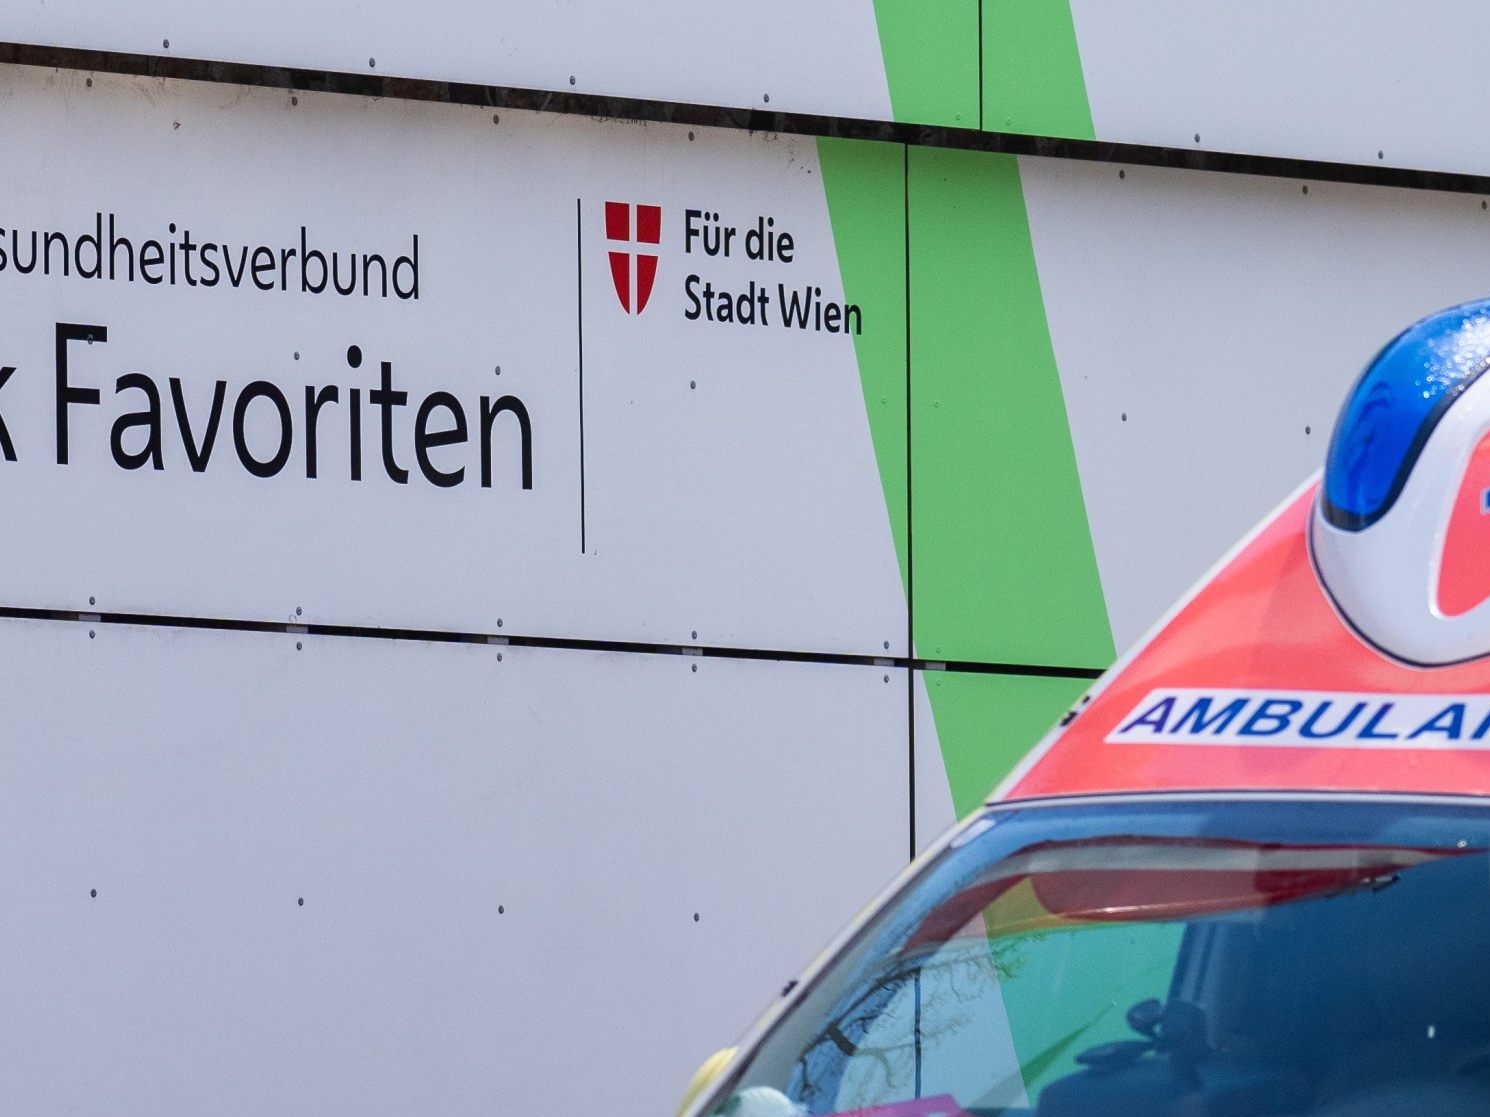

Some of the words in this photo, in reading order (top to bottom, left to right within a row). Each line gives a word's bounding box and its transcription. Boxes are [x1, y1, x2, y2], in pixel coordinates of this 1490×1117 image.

[685, 209, 737, 258] Für
[745, 216, 795, 263] die
[684, 274, 770, 326] Stadt
[778, 283, 863, 336] Wien
[55, 321, 533, 491] Favoriten
